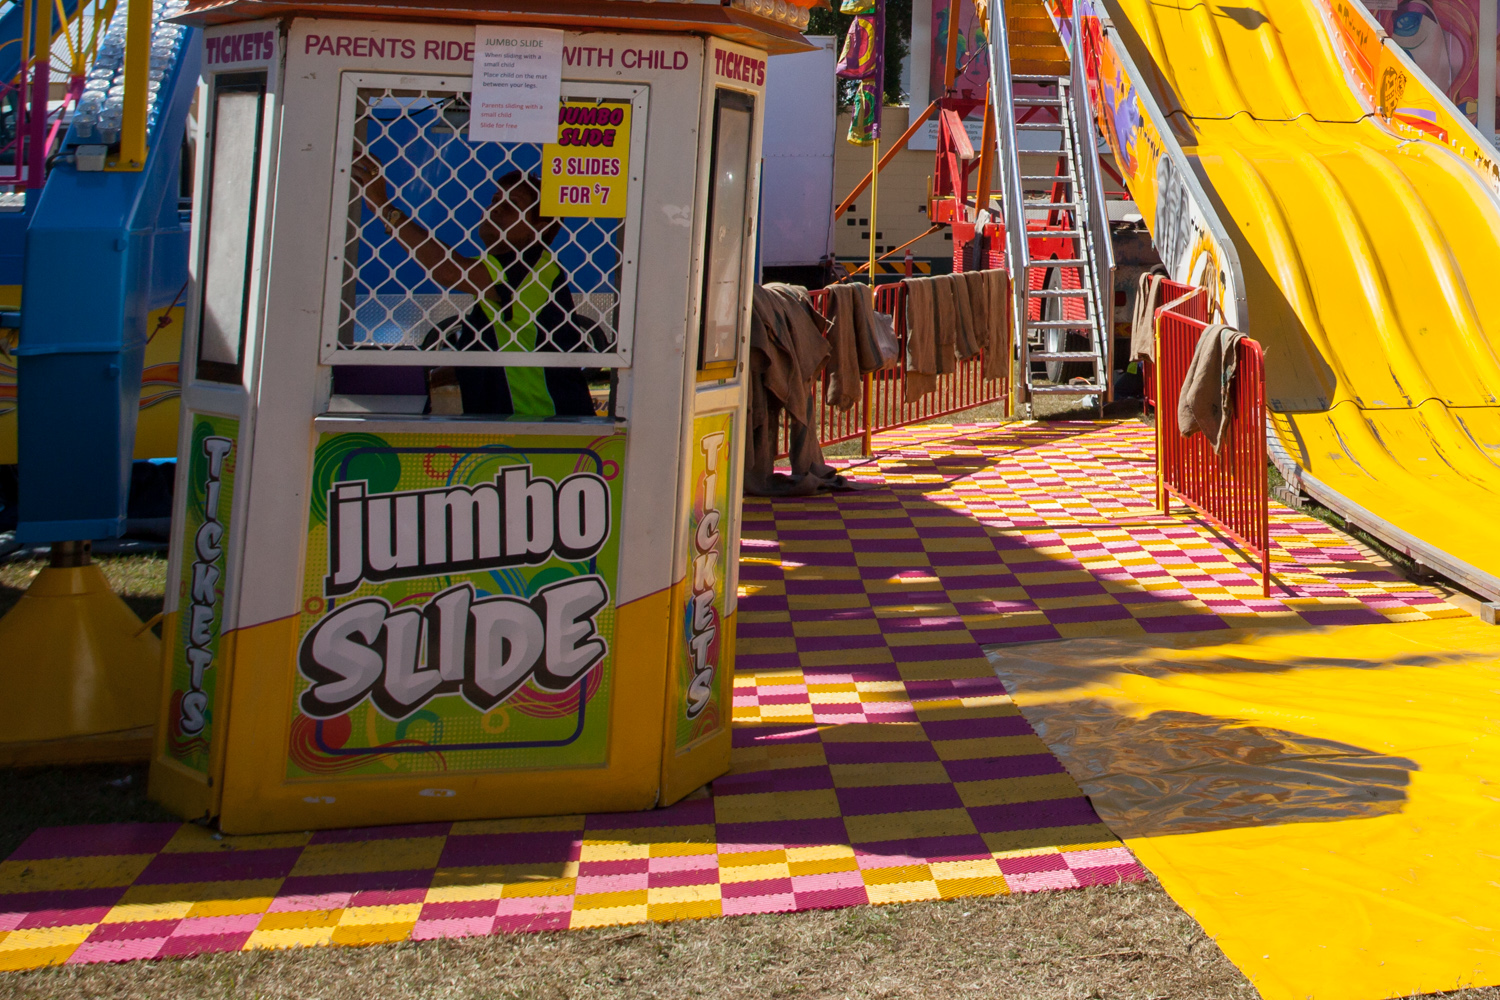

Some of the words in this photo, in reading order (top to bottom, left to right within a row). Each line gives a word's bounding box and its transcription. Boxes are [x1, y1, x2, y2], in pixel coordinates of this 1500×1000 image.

[206, 31, 274, 64] TICKETS
[305, 34, 416, 59] PARENTS
[424, 40, 476, 62] RIDE
[562, 46, 614, 68] WITH
[621, 49, 688, 70] CHILD
[486, 38, 517, 46] JUMBO
[520, 40, 543, 48] SLIDE
[714, 48, 766, 87] TICKETS
[558, 106, 624, 126] JUMBO
[558, 128, 616, 147] SLIDE
[552, 158, 562, 175] 3
[568, 158, 620, 176] SLIDES
[560, 186, 590, 204] FOR
[594, 184, 610, 204] $7
[326, 466, 610, 594] jumbo
[180, 435, 232, 736] TICKETS
[686, 430, 725, 720] TICKETS
[303, 577, 608, 717] SLIDE
